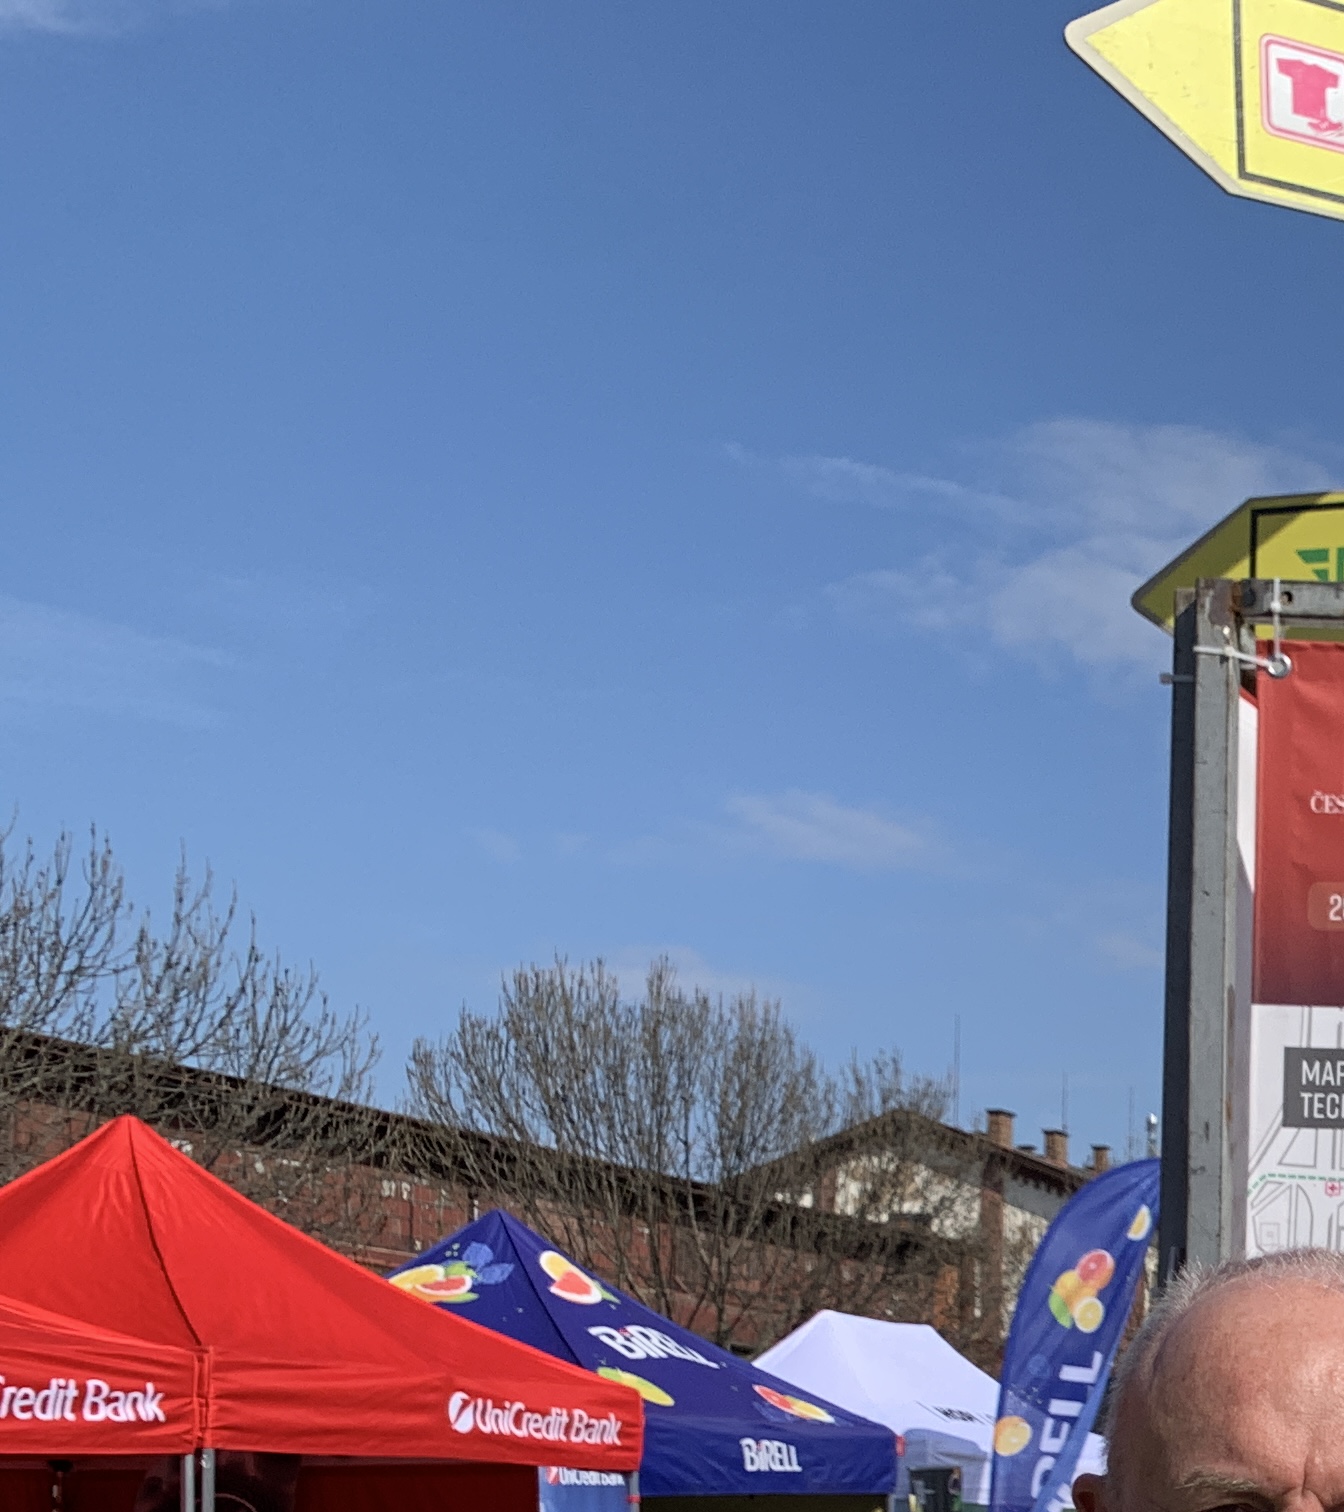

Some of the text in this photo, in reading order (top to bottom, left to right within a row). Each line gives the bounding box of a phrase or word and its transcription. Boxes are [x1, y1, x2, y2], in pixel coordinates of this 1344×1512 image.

[0, 1376, 166, 1422] redit Bank
[474, 1394, 623, 1446] UniCredit Bank
